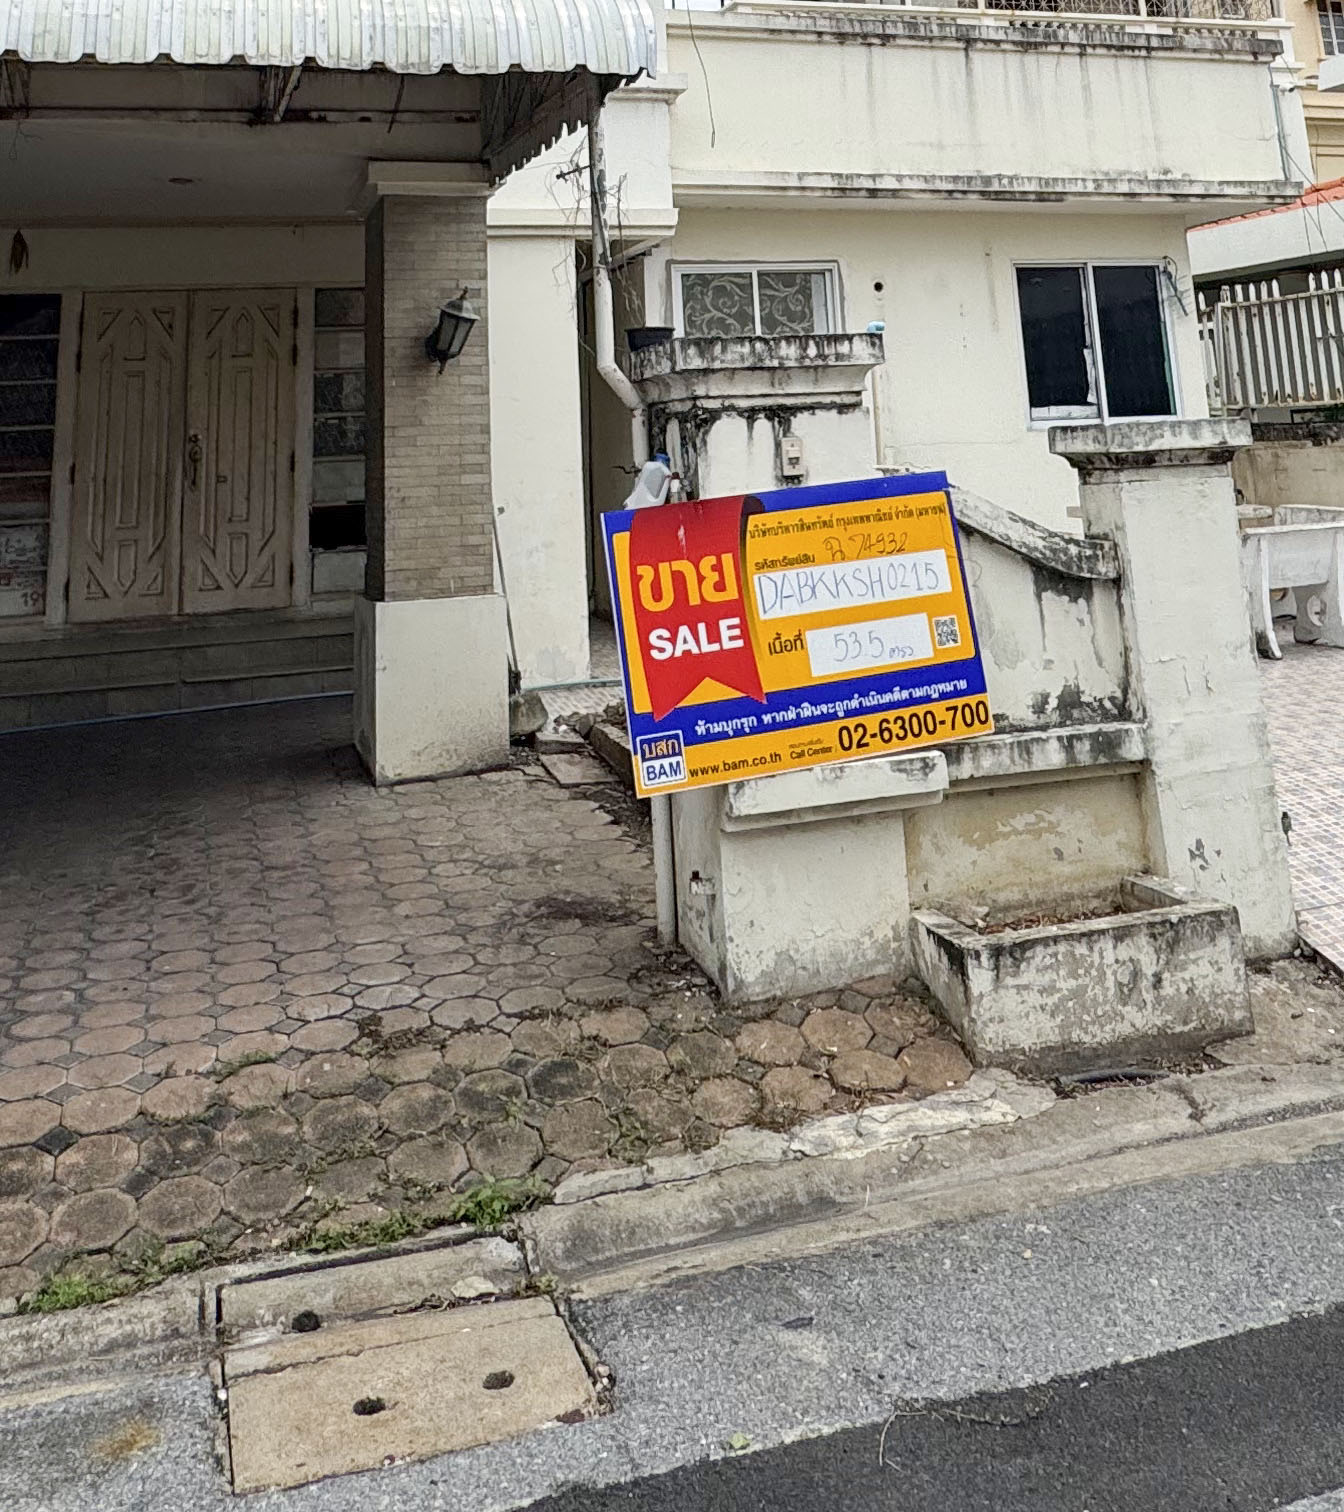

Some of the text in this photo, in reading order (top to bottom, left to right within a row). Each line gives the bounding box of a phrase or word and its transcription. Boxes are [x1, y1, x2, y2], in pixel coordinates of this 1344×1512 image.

[637, 553, 739, 612] ขาย
[758, 562, 940, 614] DABKKSH0215
[648, 617, 744, 660] SALE
[768, 629, 805, 656] เนื้อที่
[695, 715, 758, 737] ห้ามบุกรุก
[838, 700, 989, 752] 02-6300-700
[643, 739, 680, 759] บสก
[790, 749, 806, 760] Call
[646, 760, 682, 781] BAM
[689, 750, 782, 777] www.bam.co.th
